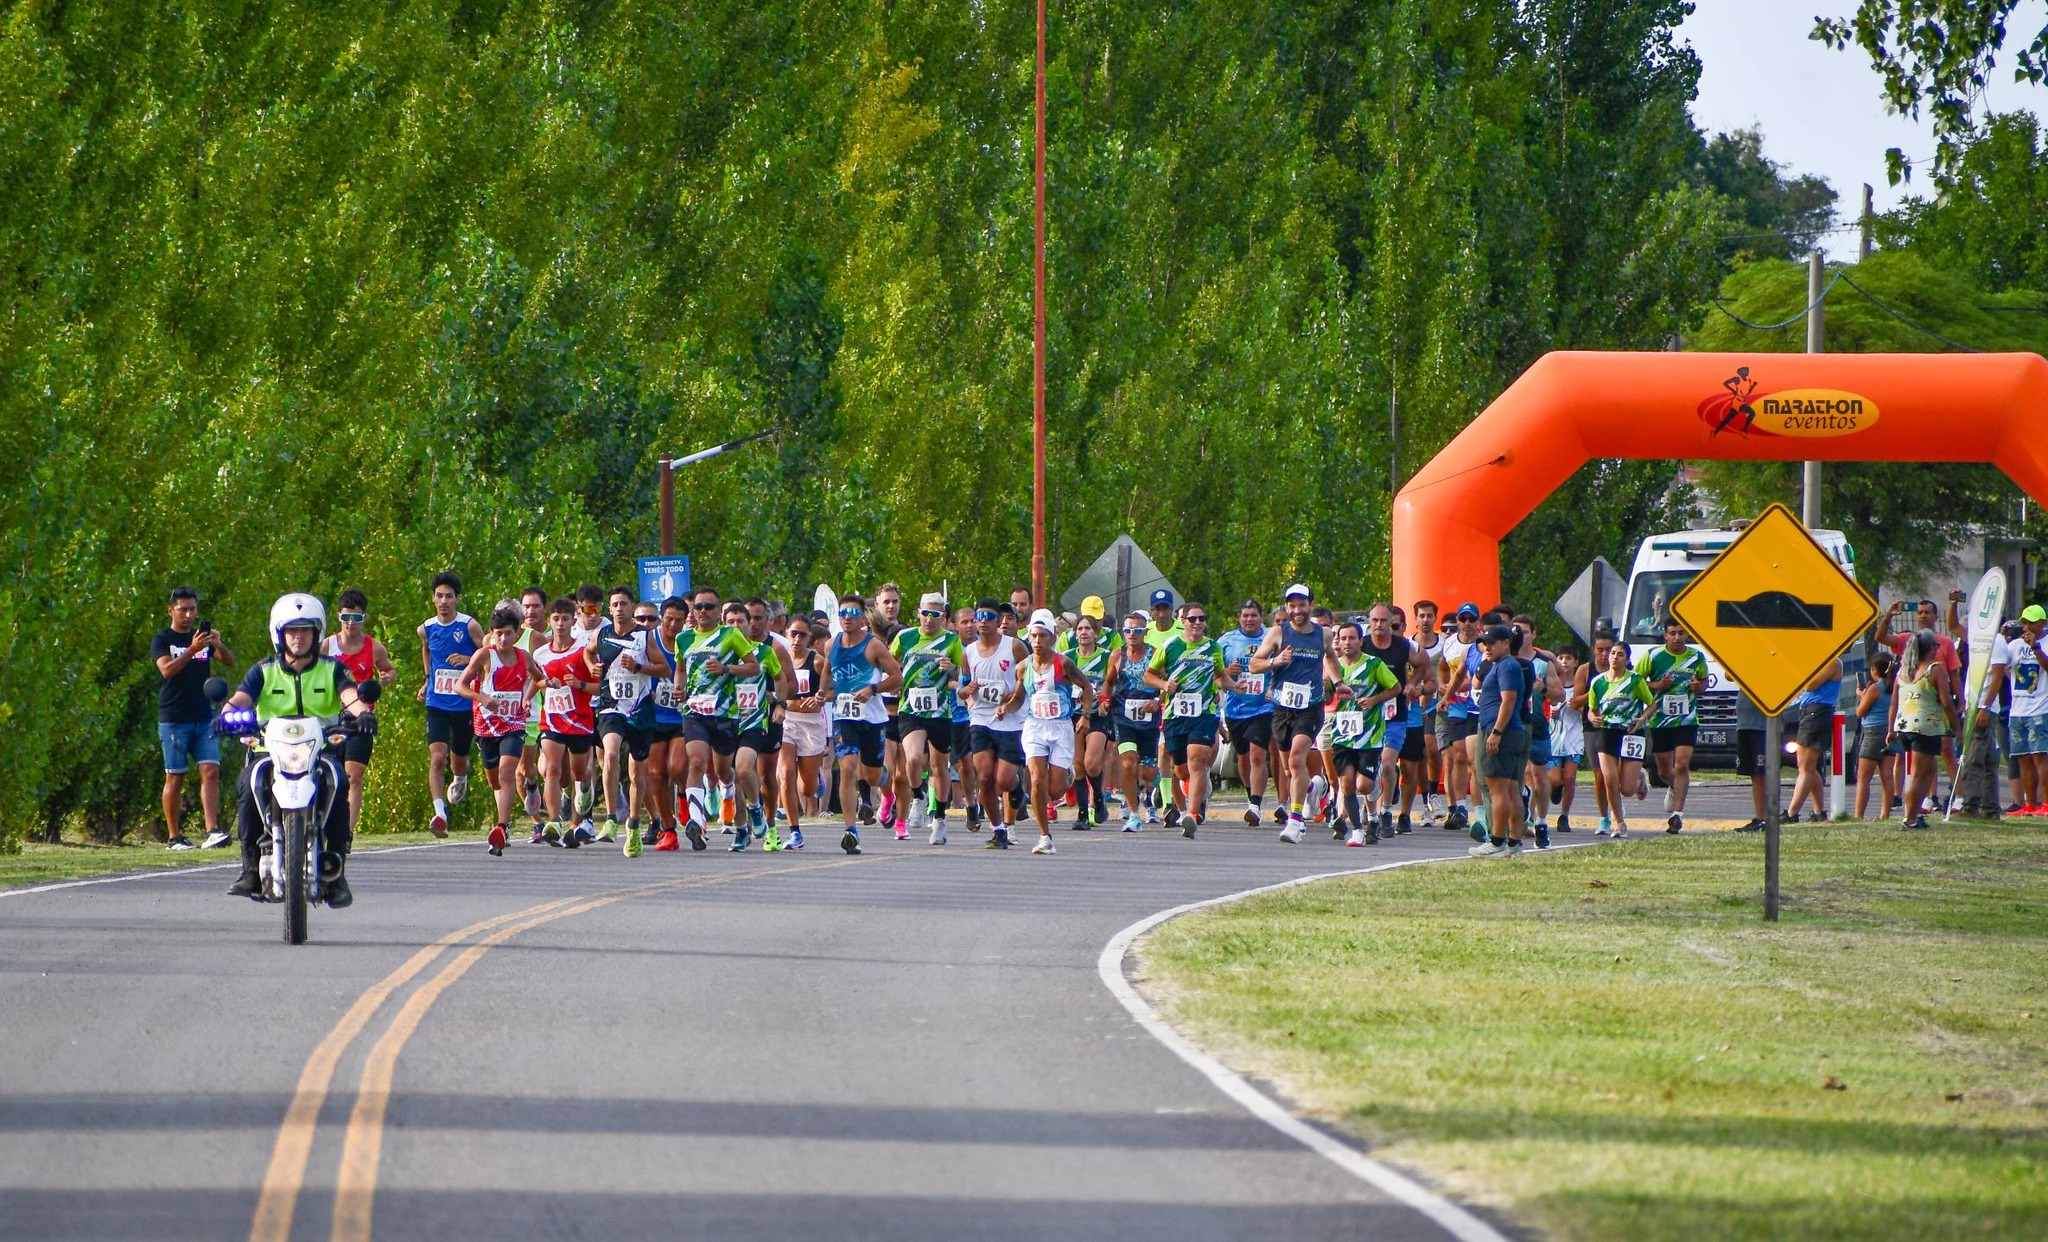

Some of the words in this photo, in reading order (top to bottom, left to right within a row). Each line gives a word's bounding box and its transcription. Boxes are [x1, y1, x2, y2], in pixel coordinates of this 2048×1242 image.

[1763, 400, 1863, 414] MARATHON
[1784, 415, 1857, 429] eventos
[436, 678, 458, 693] 44
[615, 683, 634, 699] 38
[548, 696, 574, 711] 431
[738, 692, 758, 708] 22
[914, 696, 932, 710] 46
[982, 688, 999, 704] 42
[1286, 691, 1304, 708] 30
[495, 700, 519, 716] 30
[841, 702, 861, 718] 45
[1034, 702, 1060, 718] 416
[1180, 700, 1195, 716] 31
[1669, 701, 1685, 715] 51
[1341, 720, 1358, 735] 24
[1626, 742, 1643, 757] 52
